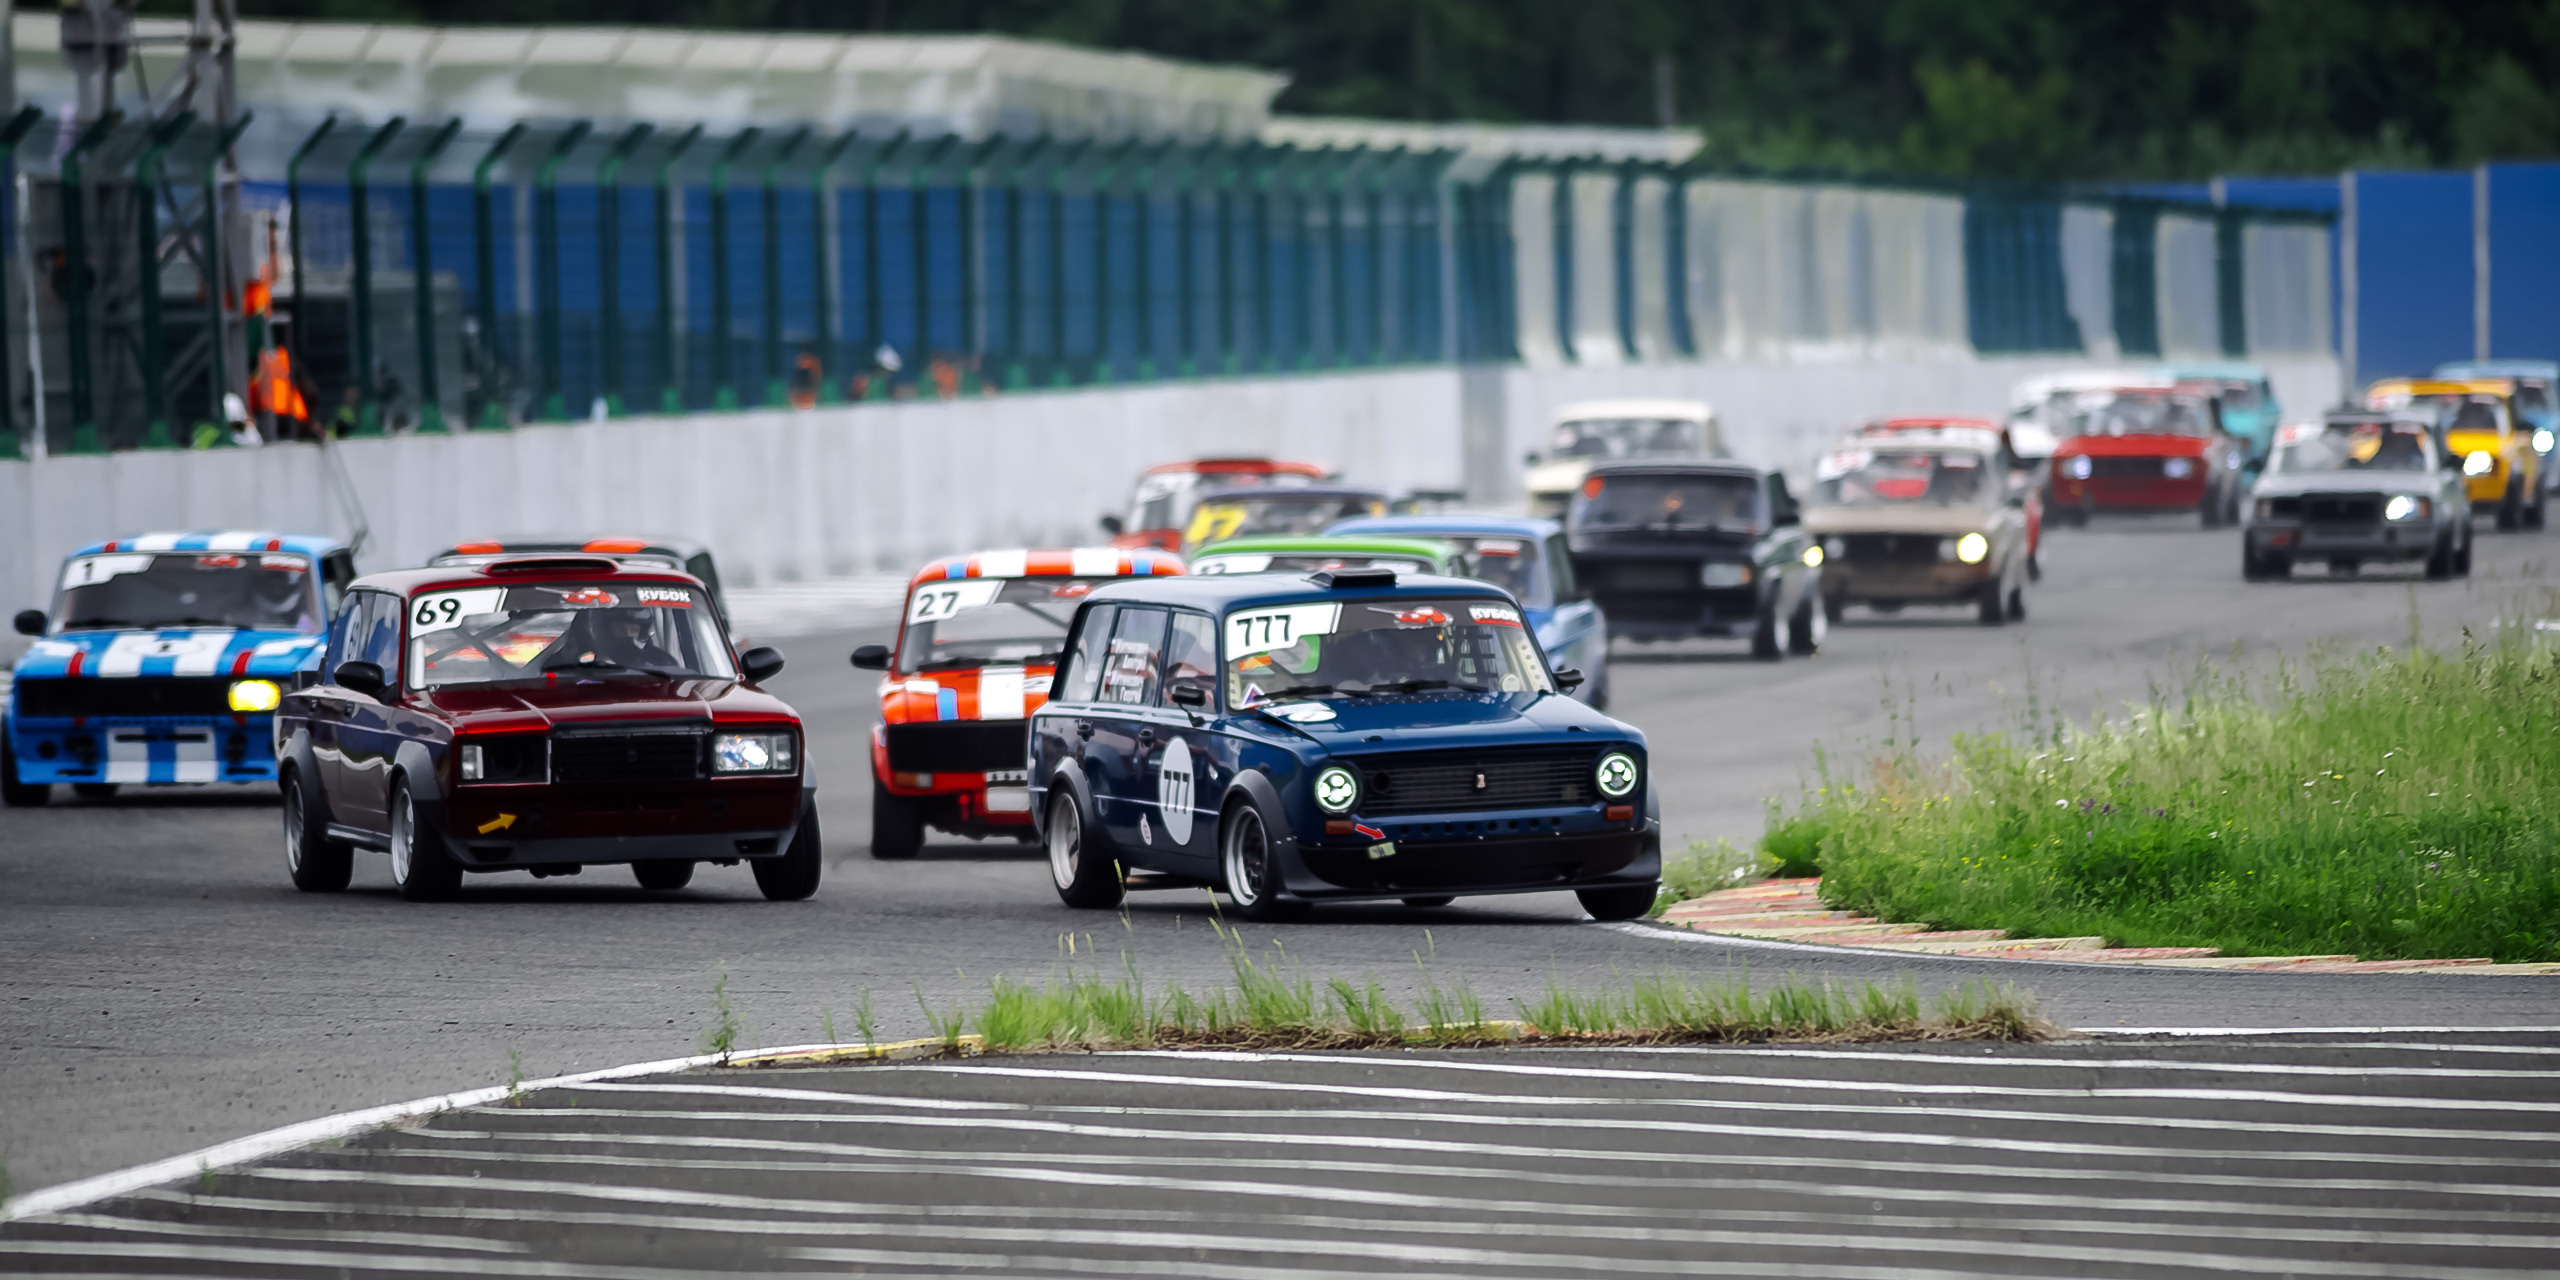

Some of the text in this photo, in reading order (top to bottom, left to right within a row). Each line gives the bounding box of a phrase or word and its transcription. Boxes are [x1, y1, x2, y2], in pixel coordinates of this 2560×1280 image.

[638, 589, 691, 603] КУБОК
[917, 591, 960, 617] 27
[415, 598, 460, 626] 69
[1469, 606, 1520, 623] КУБОК
[1236, 614, 1291, 647] 777
[1164, 770, 1190, 814] 777
